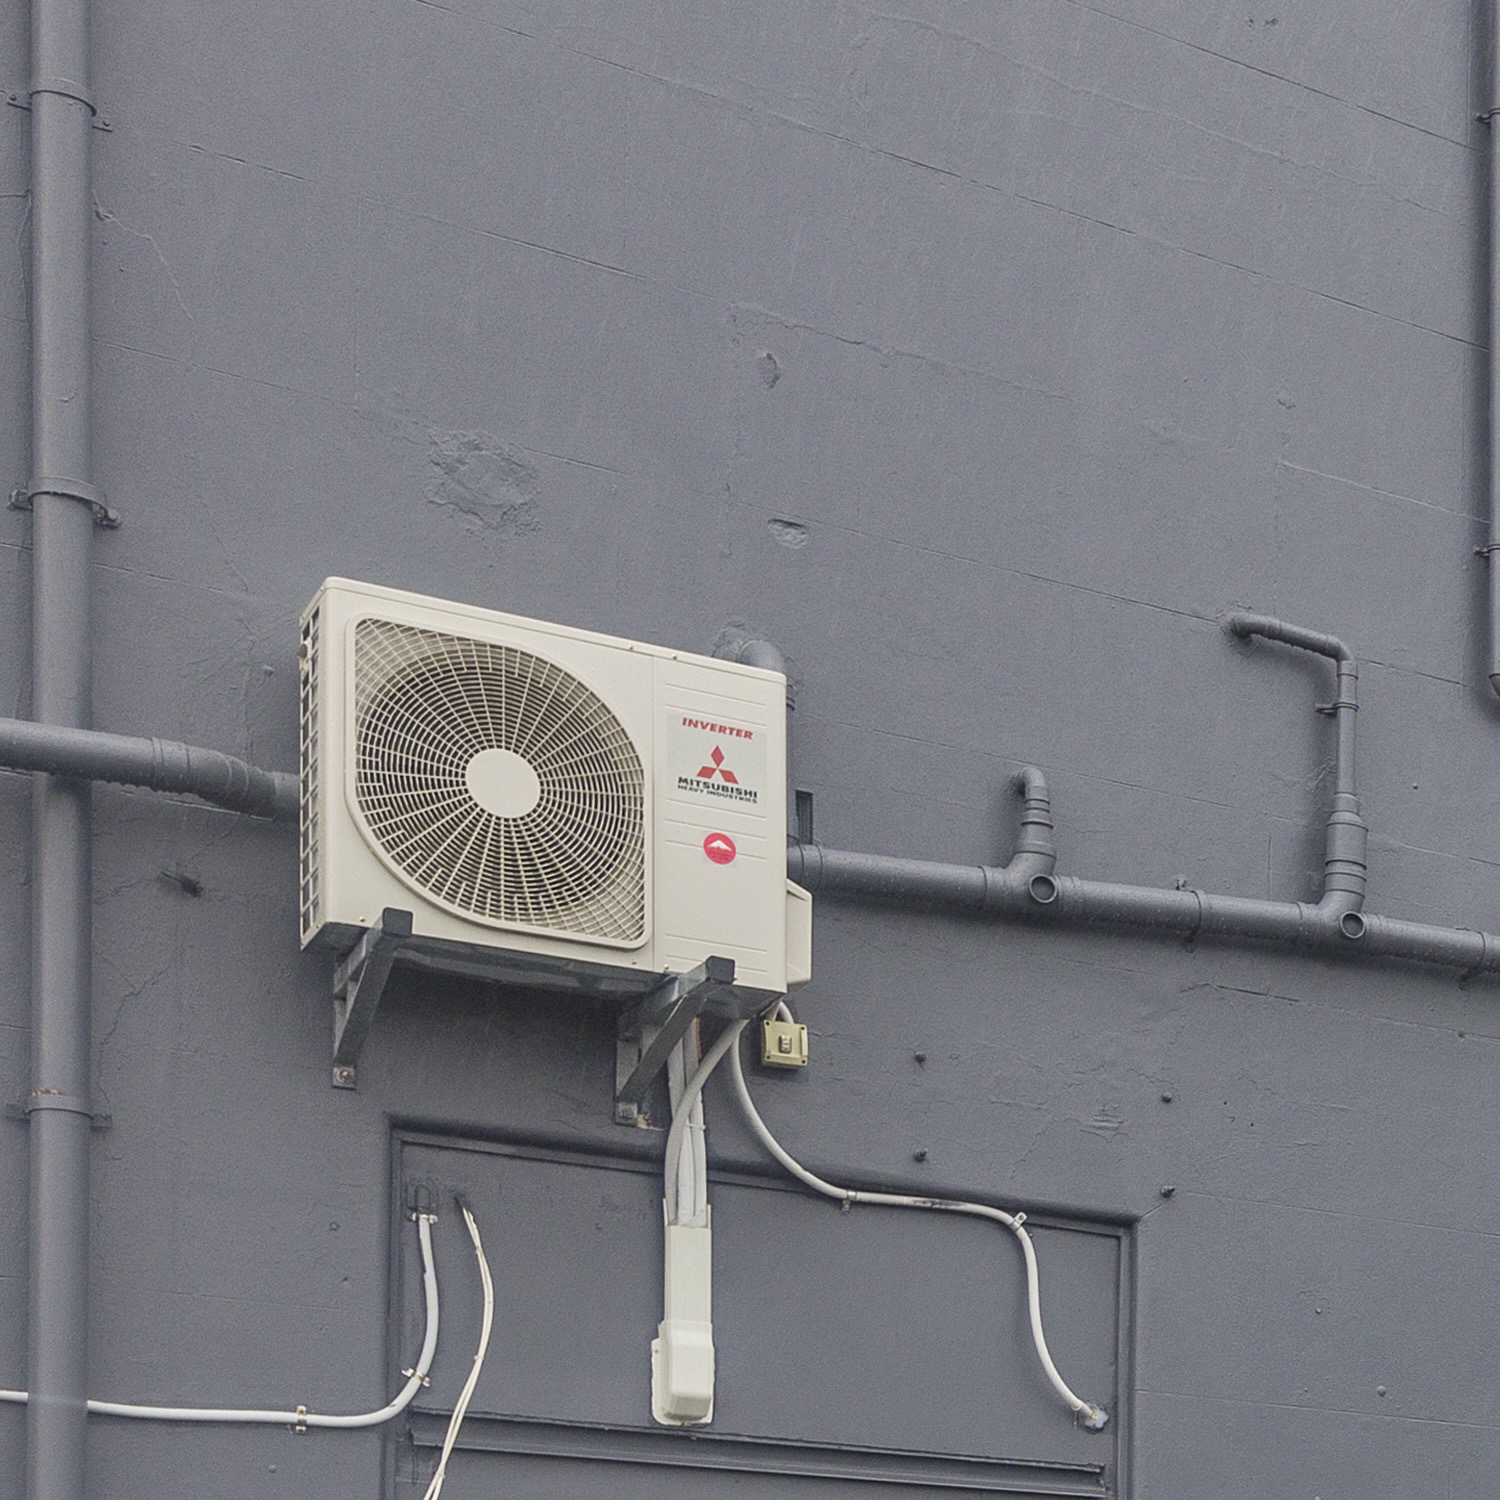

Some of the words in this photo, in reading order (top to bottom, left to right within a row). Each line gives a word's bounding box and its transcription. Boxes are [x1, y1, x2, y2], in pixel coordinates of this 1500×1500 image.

[682, 717, 754, 740] INVERTER
[677, 776, 758, 799] MITSUBISHI
[677, 784, 704, 795] HEAVY
[706, 789, 758, 804] INDUSTRIES
